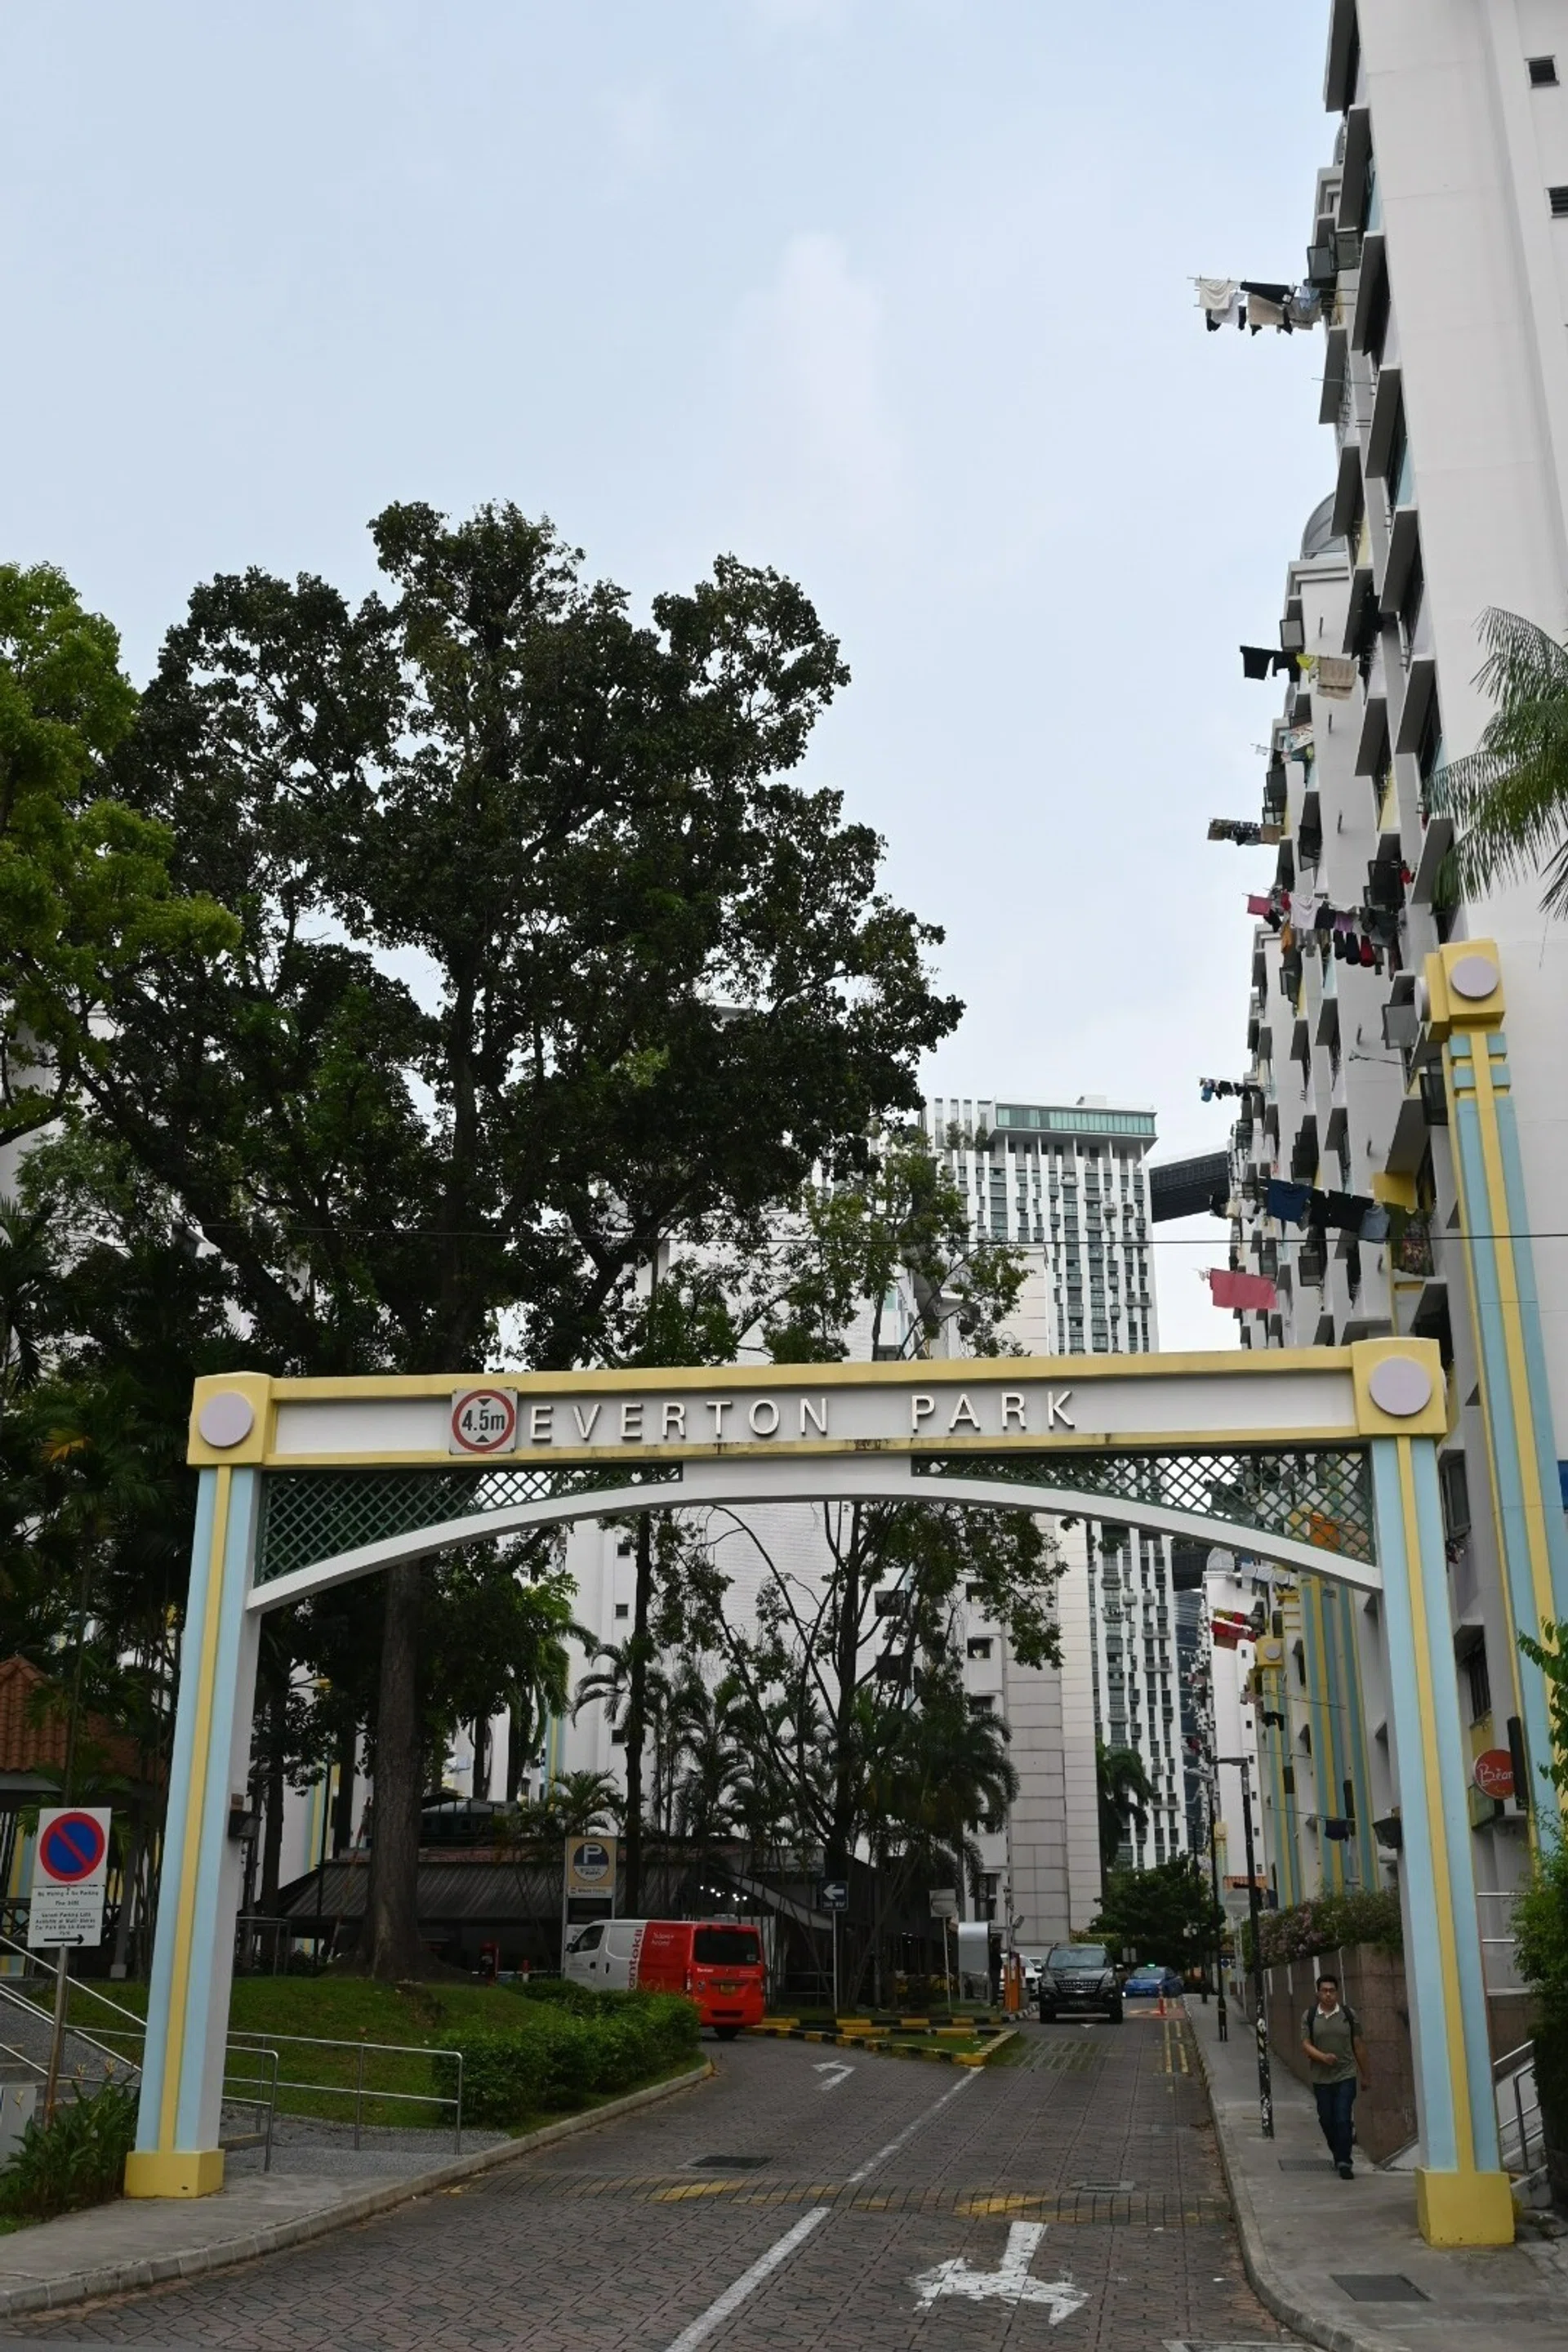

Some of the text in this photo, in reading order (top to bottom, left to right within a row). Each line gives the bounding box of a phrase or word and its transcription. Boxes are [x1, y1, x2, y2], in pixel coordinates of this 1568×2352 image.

[461, 1410, 505, 1431] 4.5m
[530, 1391, 1076, 1441] EVERTON PARK
[583, 1843, 603, 1864] P
[628, 1928, 644, 1989] entokil
